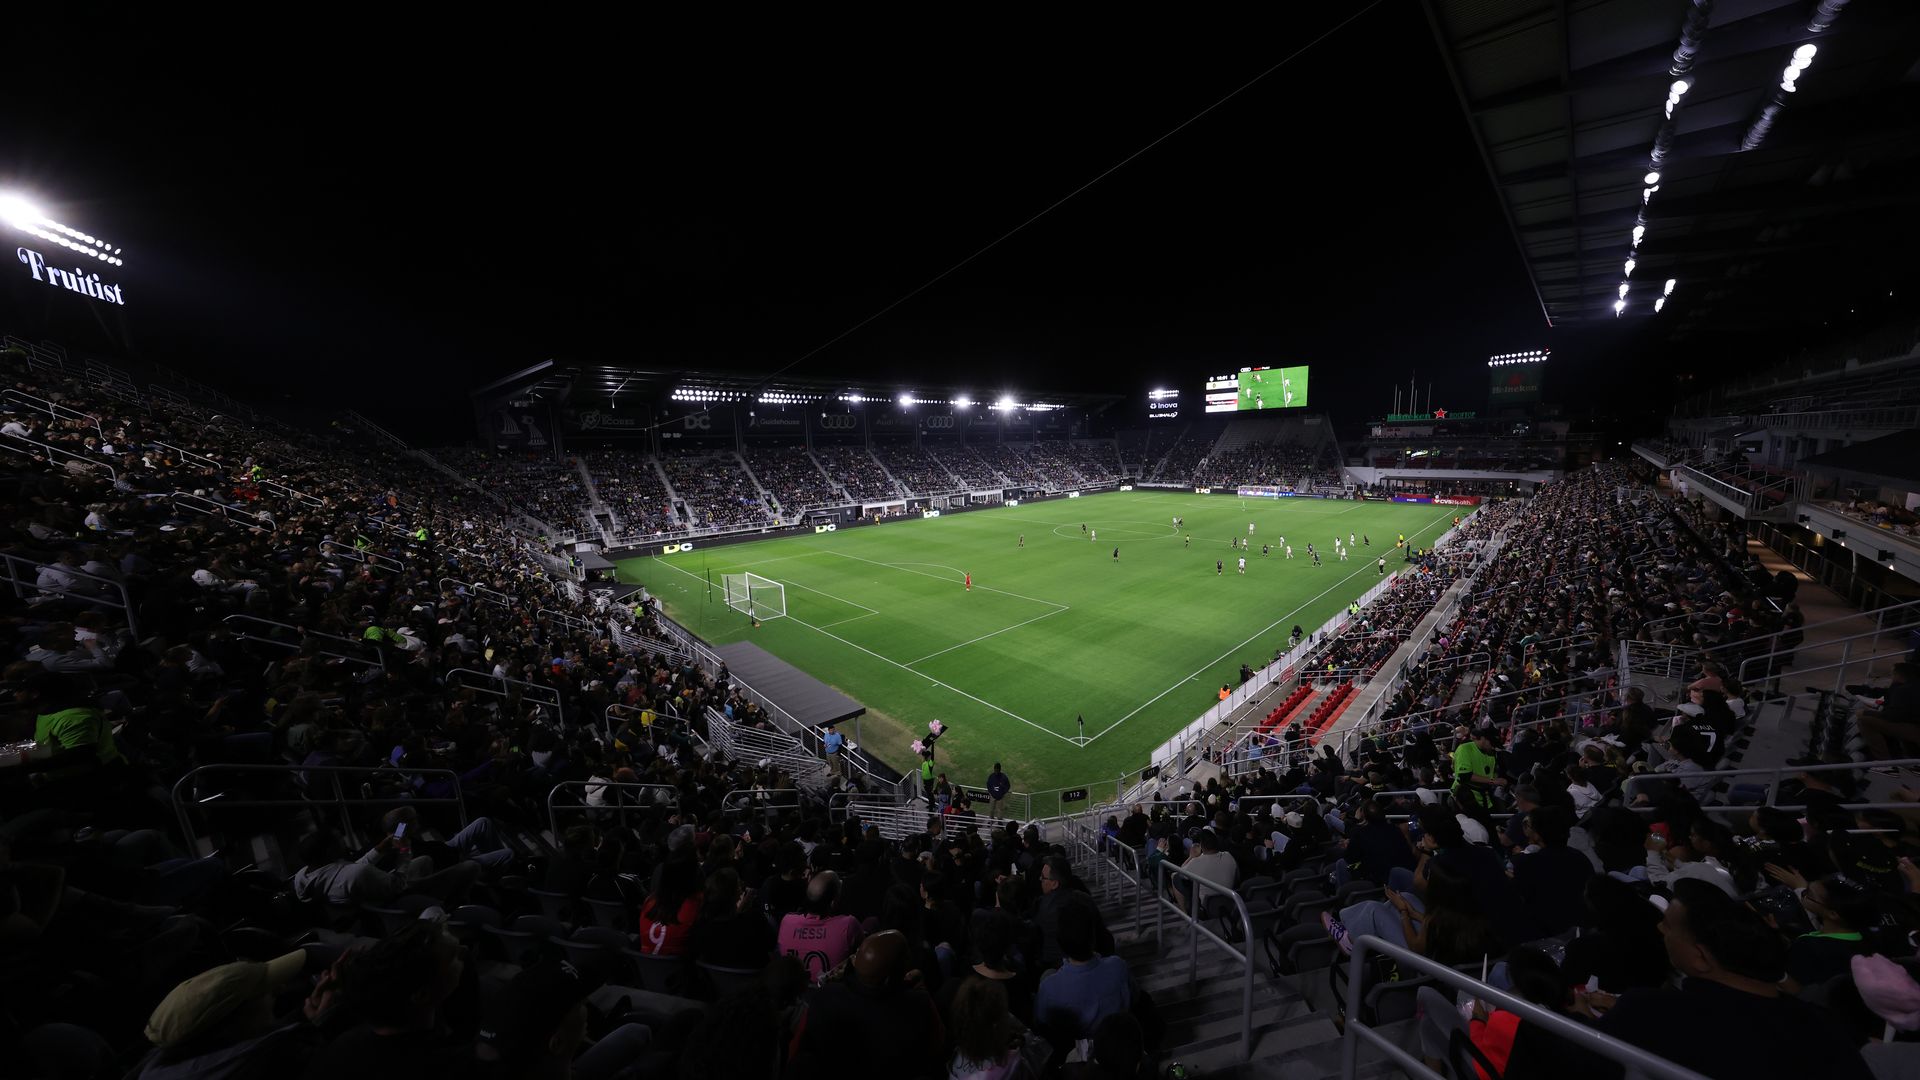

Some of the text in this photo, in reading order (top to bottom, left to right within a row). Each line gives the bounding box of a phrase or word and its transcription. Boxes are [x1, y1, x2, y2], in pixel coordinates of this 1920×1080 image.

[17, 247, 124, 305] Fruitist
[684, 415, 712, 430] DC
[815, 524, 837, 533] DC
[663, 542, 693, 554] DC
[1700, 731, 1717, 752] 7
[649, 920, 667, 955] 9
[793, 927, 827, 939] MESSI
